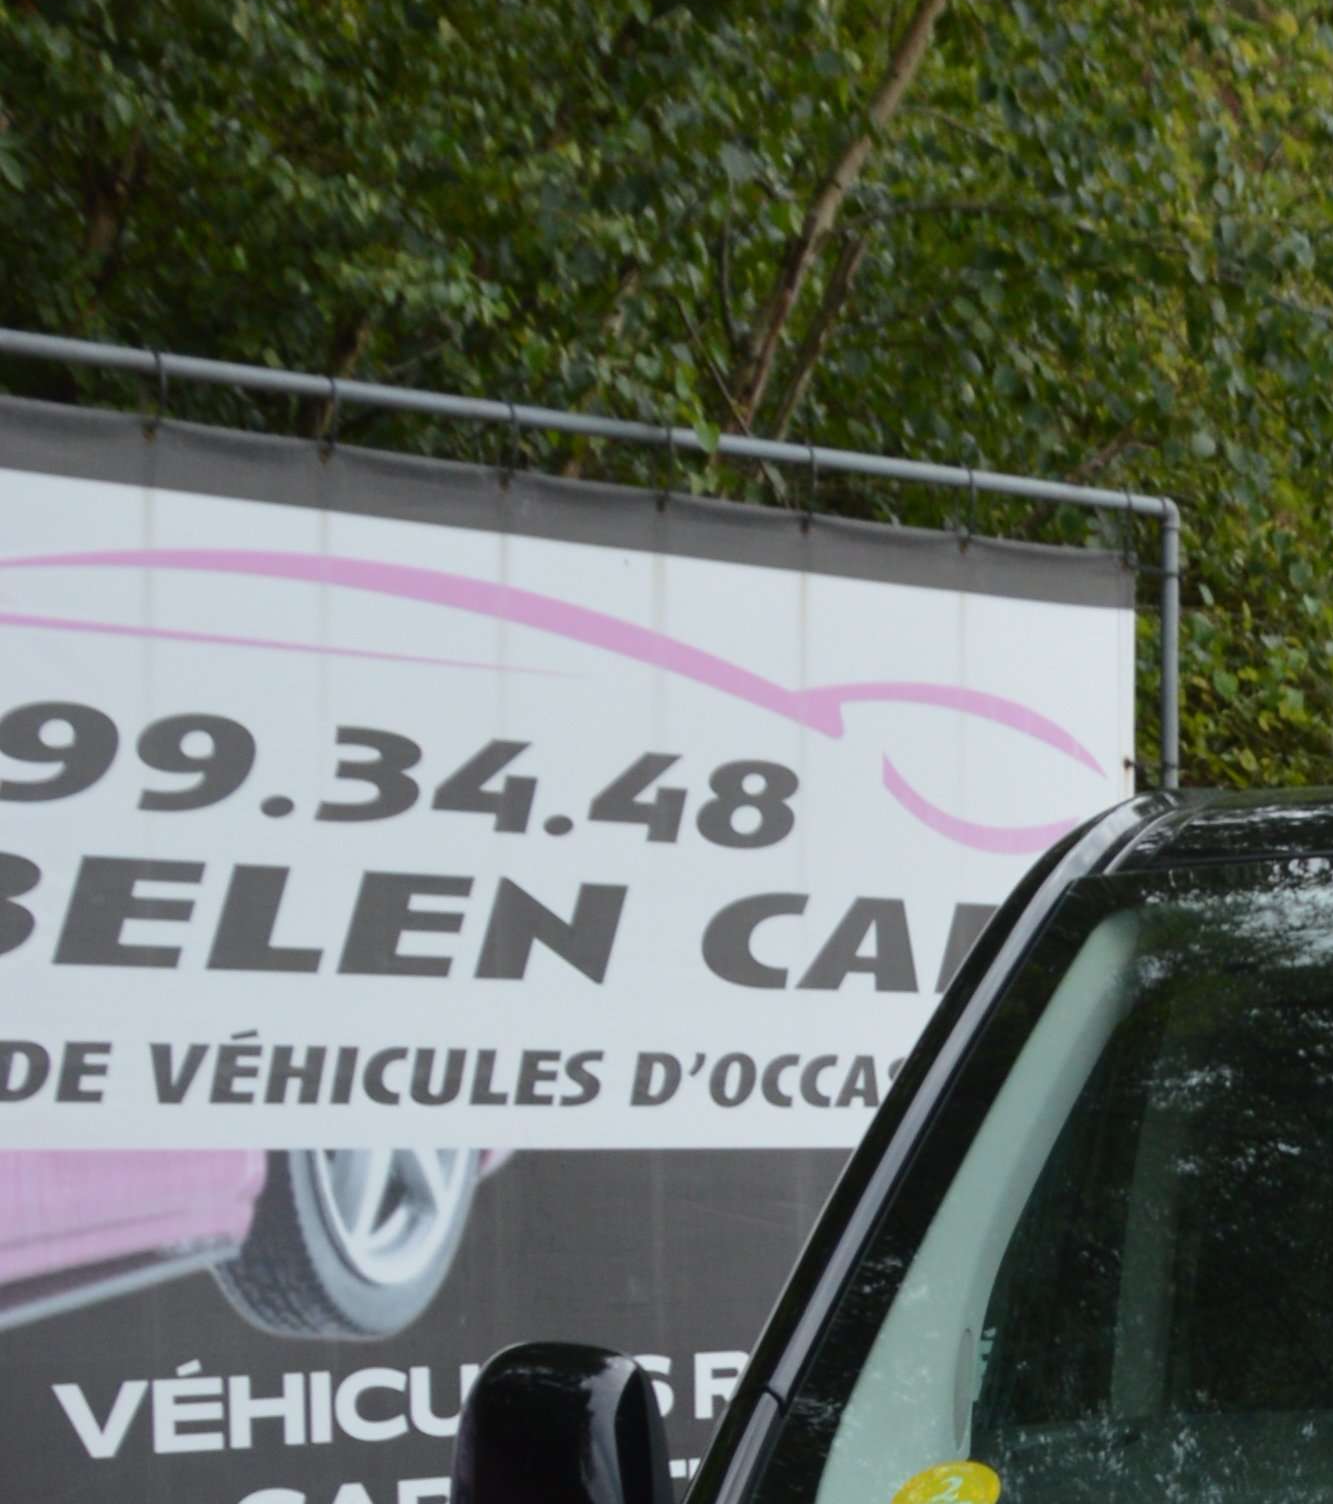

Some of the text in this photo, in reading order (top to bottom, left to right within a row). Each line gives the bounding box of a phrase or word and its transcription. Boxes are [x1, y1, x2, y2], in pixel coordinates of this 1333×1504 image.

[0, 701, 800, 849] 99.34.48
[0, 1030, 906, 1108] DE VÉHICULES D’OCCA
